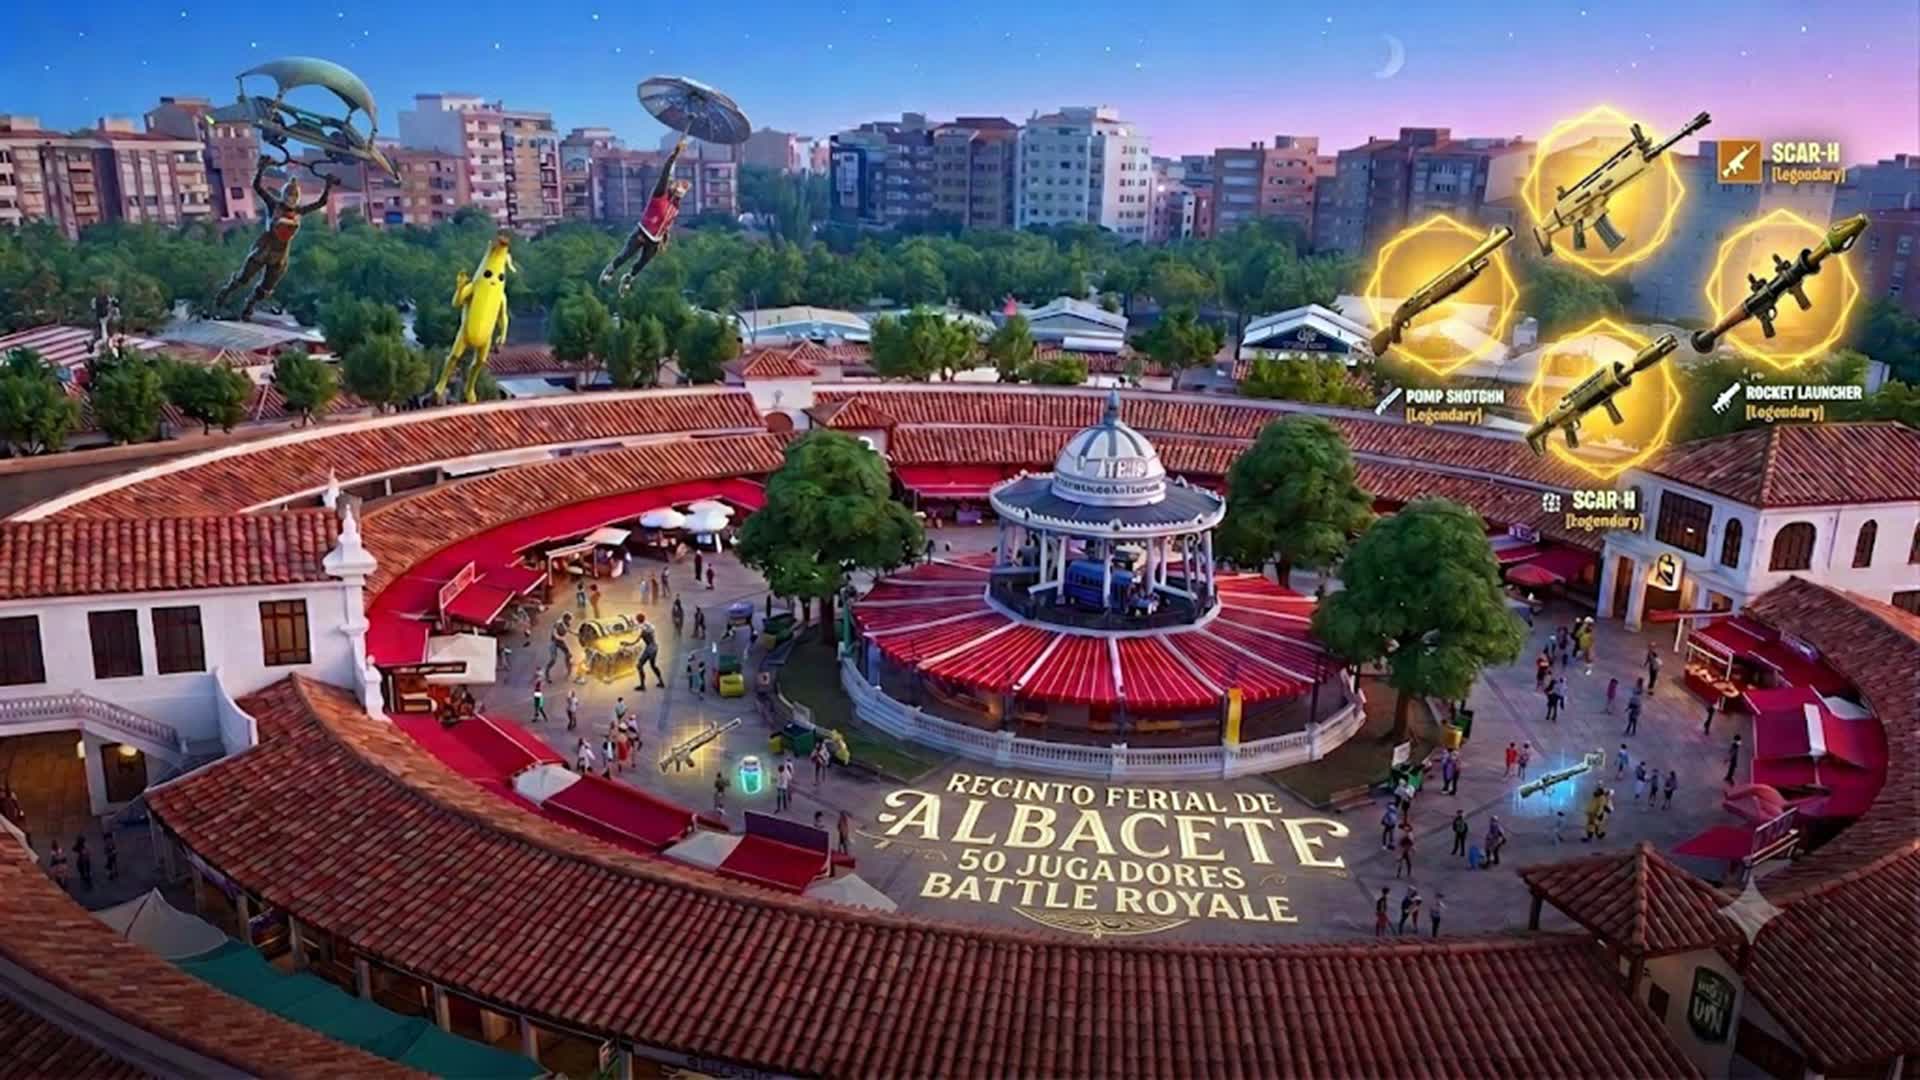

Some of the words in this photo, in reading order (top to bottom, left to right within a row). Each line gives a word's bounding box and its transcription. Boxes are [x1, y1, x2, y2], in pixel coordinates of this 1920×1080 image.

[947, 773, 1095, 805] RECINTO
[1106, 787, 1228, 813] FERIAL
[1234, 792, 1282, 814] DE
[878, 789, 1350, 868] ALBACETE
[958, 848, 1006, 873] 50
[1016, 854, 1245, 889] JUGADORES
[920, 872, 1098, 910] BATTLE
[1115, 886, 1298, 922] ROYALE
